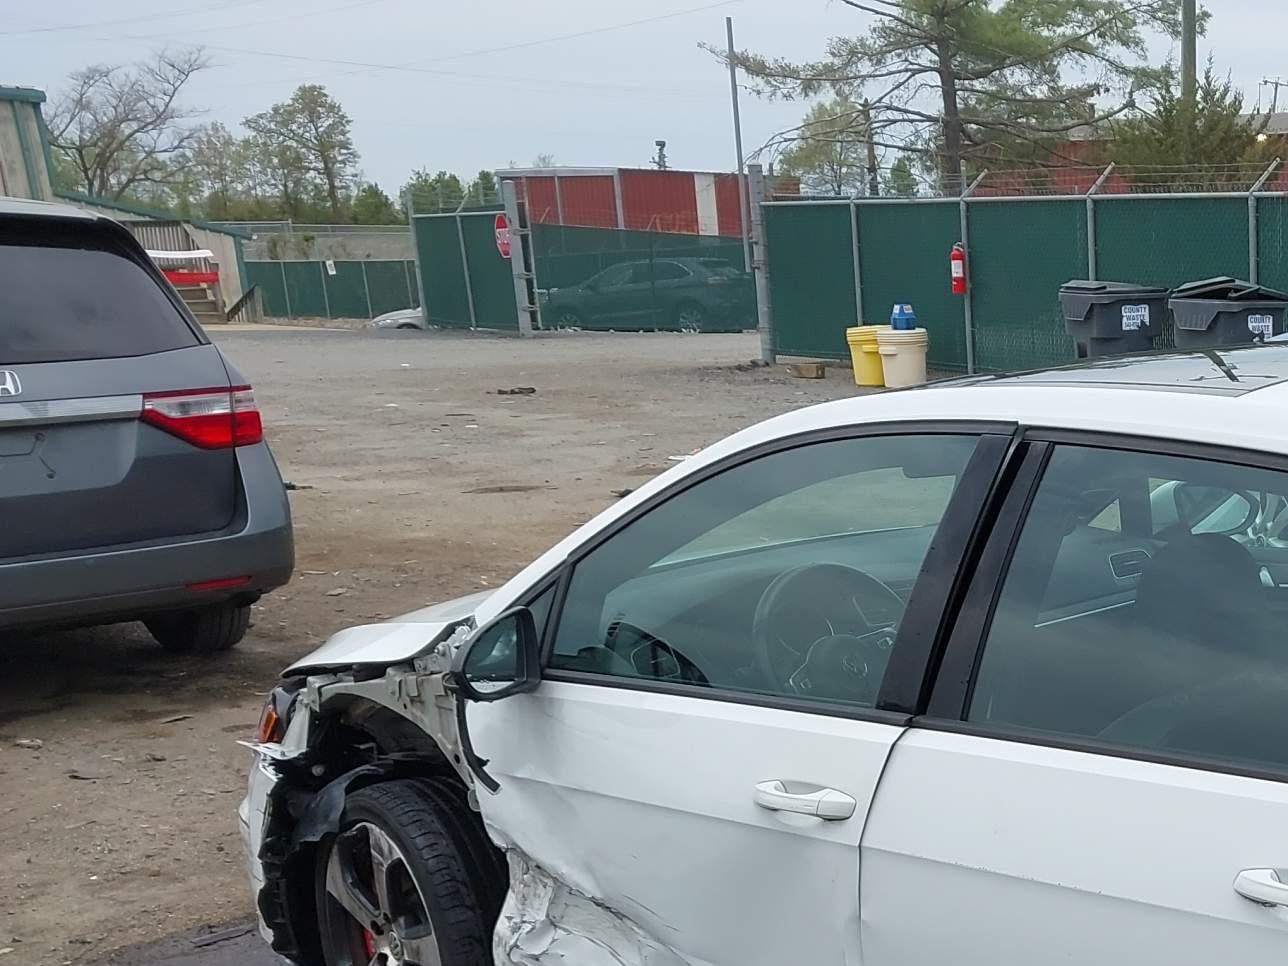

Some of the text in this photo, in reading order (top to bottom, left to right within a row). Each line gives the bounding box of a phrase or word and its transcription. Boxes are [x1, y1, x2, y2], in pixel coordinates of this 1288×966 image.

[1123, 305, 1147, 314] COUNTY
[1126, 313, 1146, 322] WASTE
[1249, 316, 1271, 324] COUNTY
[1251, 324, 1270, 332] WASTE
